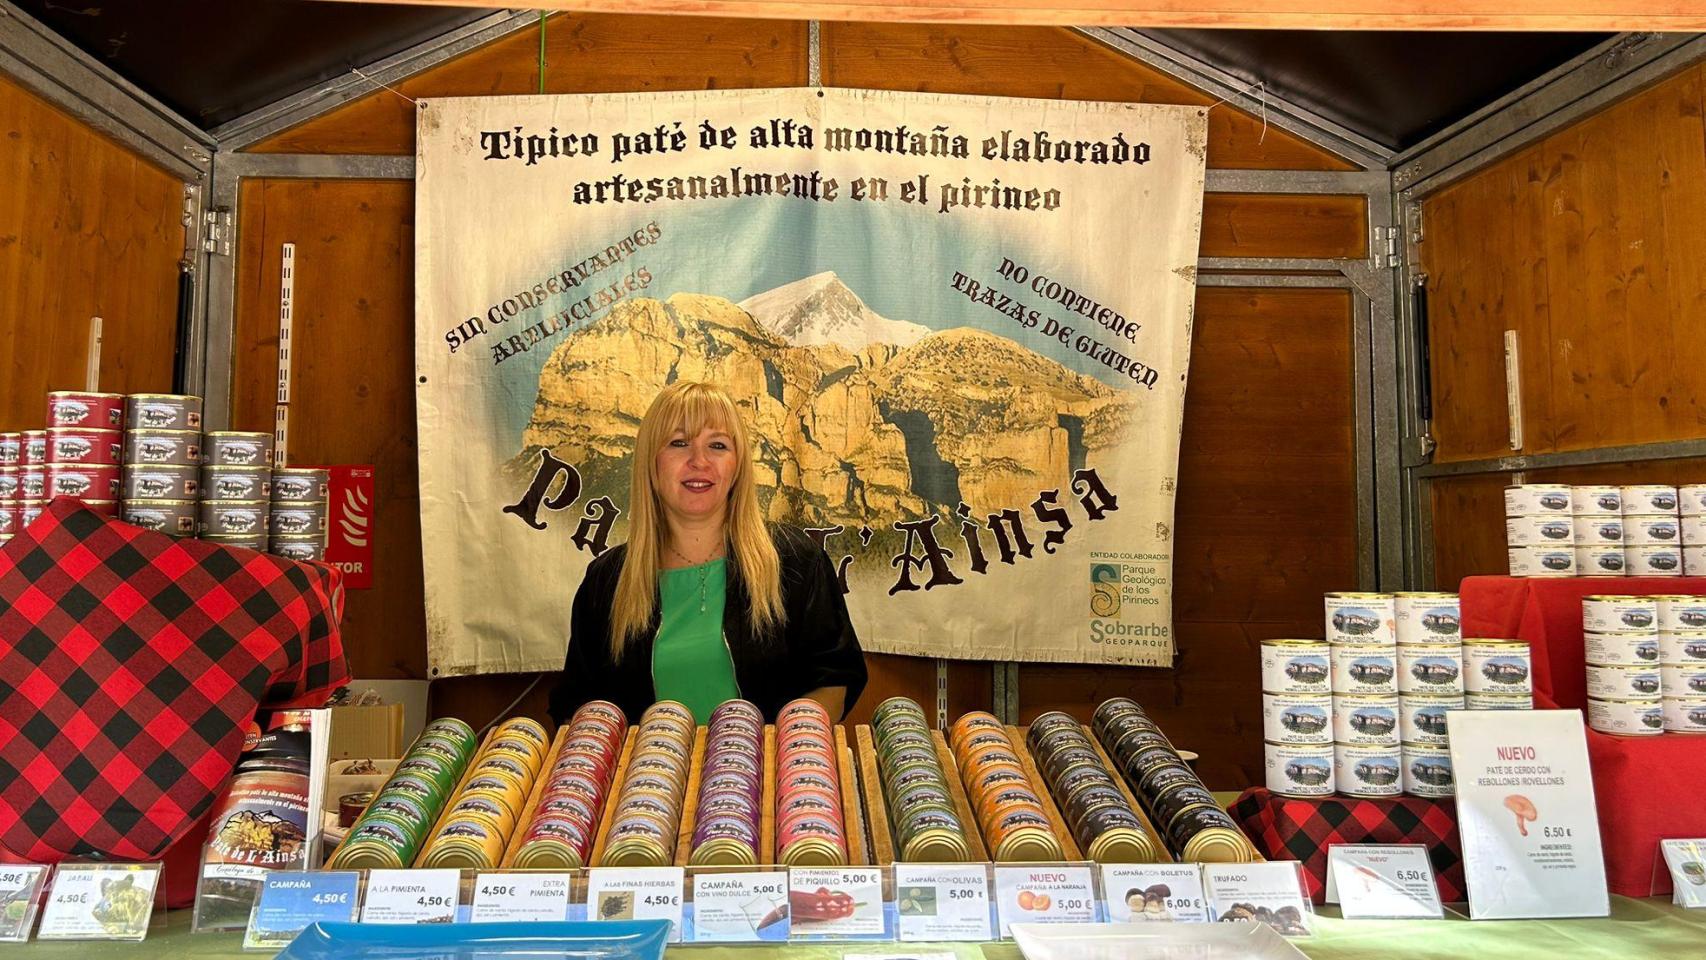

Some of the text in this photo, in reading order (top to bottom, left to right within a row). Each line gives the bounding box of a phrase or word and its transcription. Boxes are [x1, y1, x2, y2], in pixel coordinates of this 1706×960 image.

[480, 118, 1151, 166] Típico paté de alta montaña elaborado
[573, 166, 1061, 213] artesanalmente en el pirineo
[445, 221, 663, 353] SIN CONSERVANTES
[995, 257, 1142, 344] NO CONTIENE
[951, 271, 1159, 391] TRAZAS DE GLUTEN
[1122, 565, 1156, 575] Parque
[1122, 575, 1167, 587] Geológico
[1122, 585, 1150, 595] de los
[1122, 595, 1159, 605] Pirineos
[1090, 620, 1168, 643] Sobrarbe
[1105, 639, 1167, 647] GEOPARQUE
[1497, 746, 1536, 761] NUEVO
[1504, 766, 1513, 774] DE
[1514, 766, 1536, 774] CERDO
[1537, 766, 1551, 774] CON
[1478, 777, 1520, 786] REBOLLONES
[1030, 873, 1066, 883] NUEVO
[1113, 869, 1144, 877] CAMPAÑA
[1397, 870, 1419, 880] 6,50
[269, 879, 312, 889] CAMPAÑA
[644, 880, 675, 888] HIERBAS
[701, 879, 744, 889] CAMPAÑA
[794, 878, 841, 886] DE PIQUILLO
[842, 874, 867, 884] 5,00
[952, 877, 983, 885] OLIVAS
[390, 885, 426, 893] PIMIENTA
[481, 886, 507, 897] 4,50
[753, 885, 774, 894] 5,00
[950, 889, 974, 899] 5,00
[312, 893, 338, 904] 4,50
[417, 896, 442, 906] 4,50
[644, 895, 669, 906] 4,50
[1058, 899, 1081, 910] 5,00
[1167, 899, 1190, 909] 6,00
